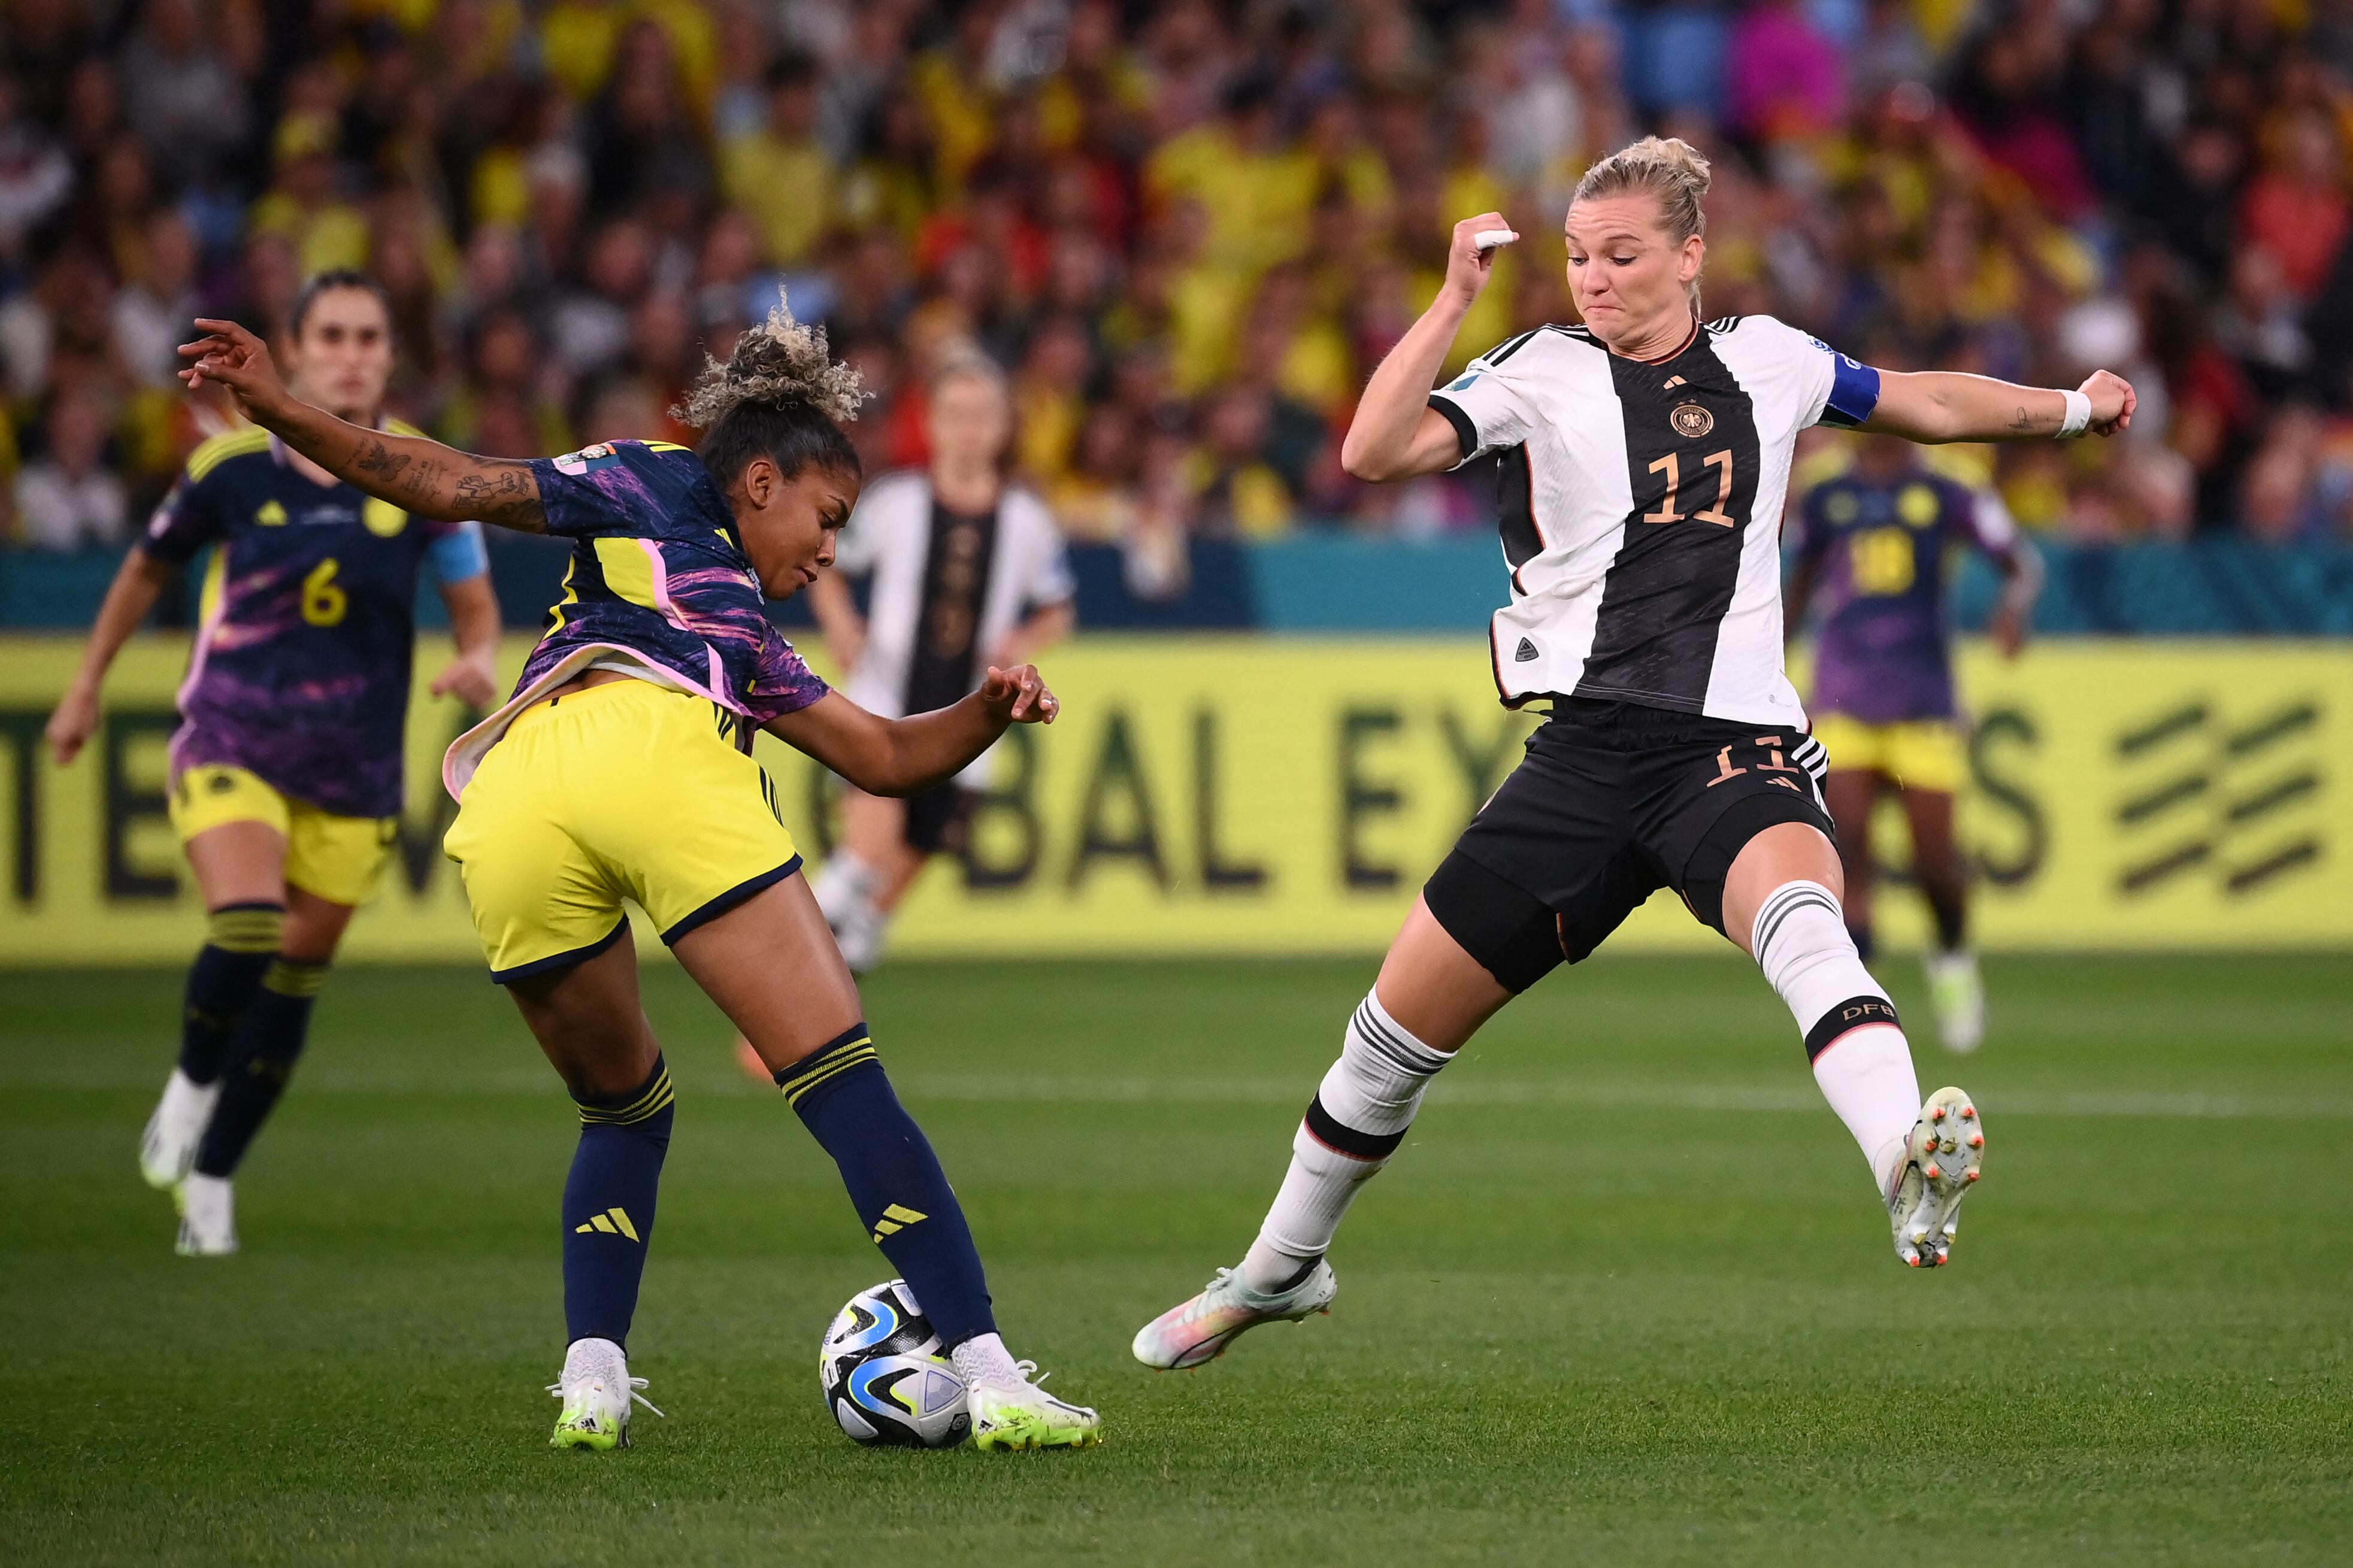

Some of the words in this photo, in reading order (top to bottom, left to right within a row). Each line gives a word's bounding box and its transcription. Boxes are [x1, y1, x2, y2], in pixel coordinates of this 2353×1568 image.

[1643, 449, 1734, 528] 11
[302, 556, 346, 627] 6
[1706, 735, 1800, 787] 11
[1842, 1003, 1895, 1021] DFB
